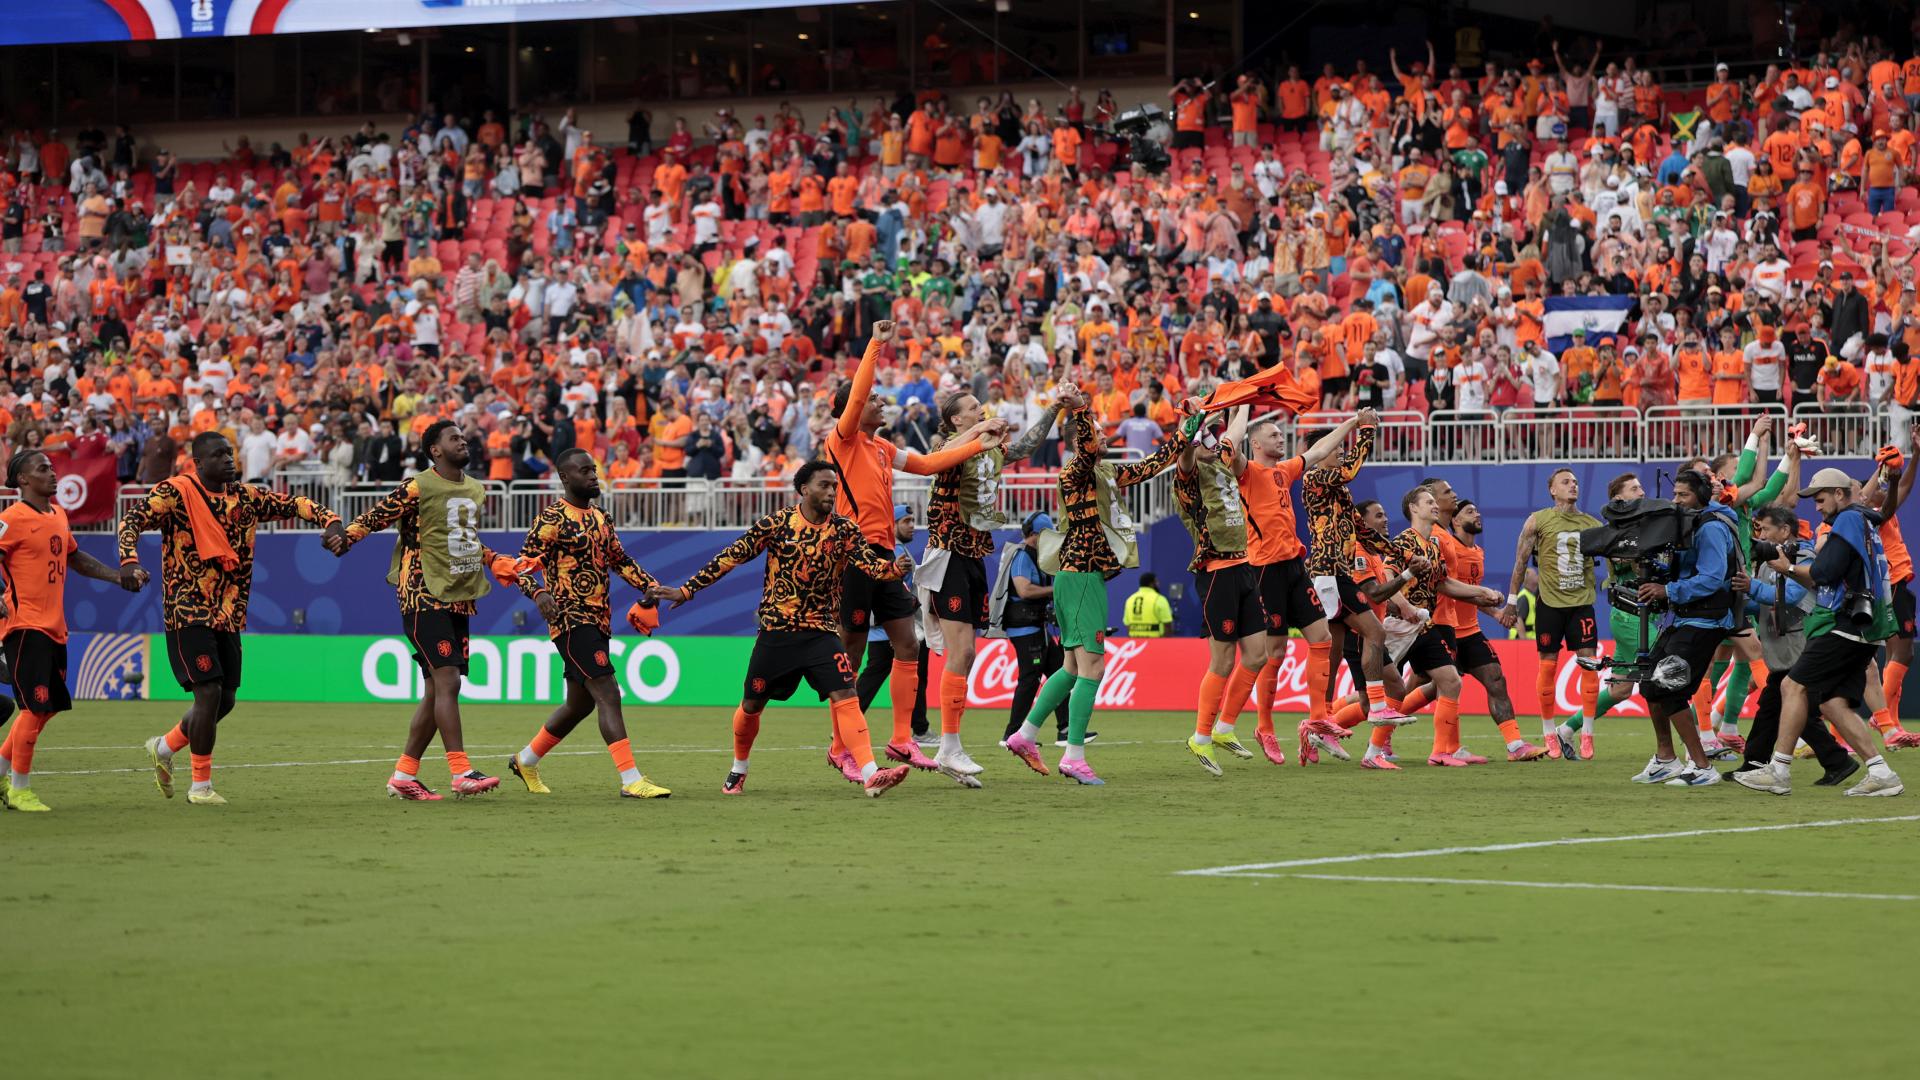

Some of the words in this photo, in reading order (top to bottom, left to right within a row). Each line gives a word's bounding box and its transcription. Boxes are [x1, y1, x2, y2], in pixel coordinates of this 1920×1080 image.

[1776, 143, 1792, 163] 12
[1352, 323, 1363, 342] 11
[48, 560, 65, 584] 24
[450, 563, 481, 575] 2026
[1580, 618, 1595, 636] 17
[362, 638, 680, 702] aamo
